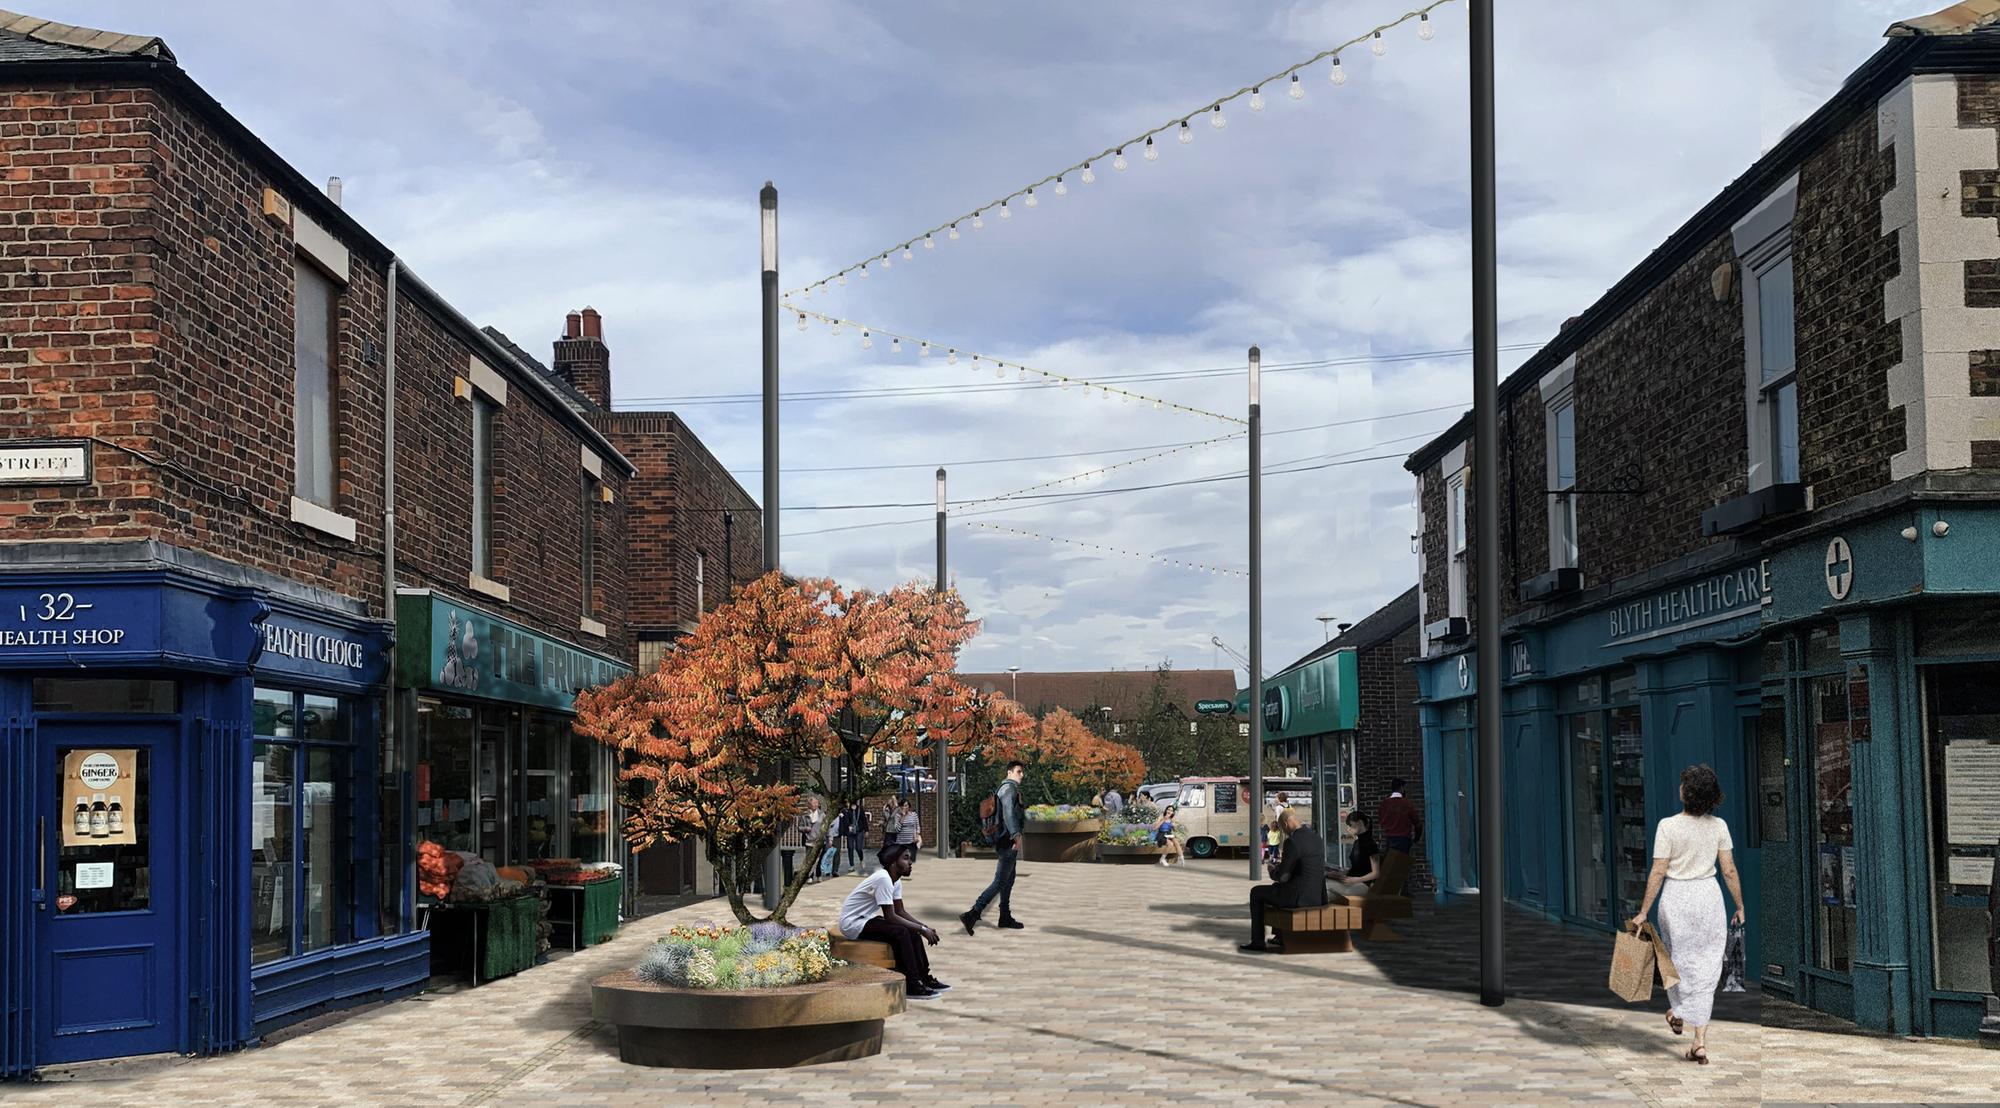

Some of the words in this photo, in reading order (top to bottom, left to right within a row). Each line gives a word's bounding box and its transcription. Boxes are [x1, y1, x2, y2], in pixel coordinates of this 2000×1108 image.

[1610, 600, 1653, 637] BLYTH
[1658, 559, 1772, 625] HEALTHCARE
[0, 630, 67, 645] EALTH
[73, 629, 124, 644] SHOP
[316, 635, 363, 668] CHOICE
[489, 623, 536, 687] THE
[542, 641, 594, 695] FRUIT
[1512, 644, 1531, 673] NH
[1198, 702, 1229, 711] Specsavers
[82, 768, 118, 778] GINGER
